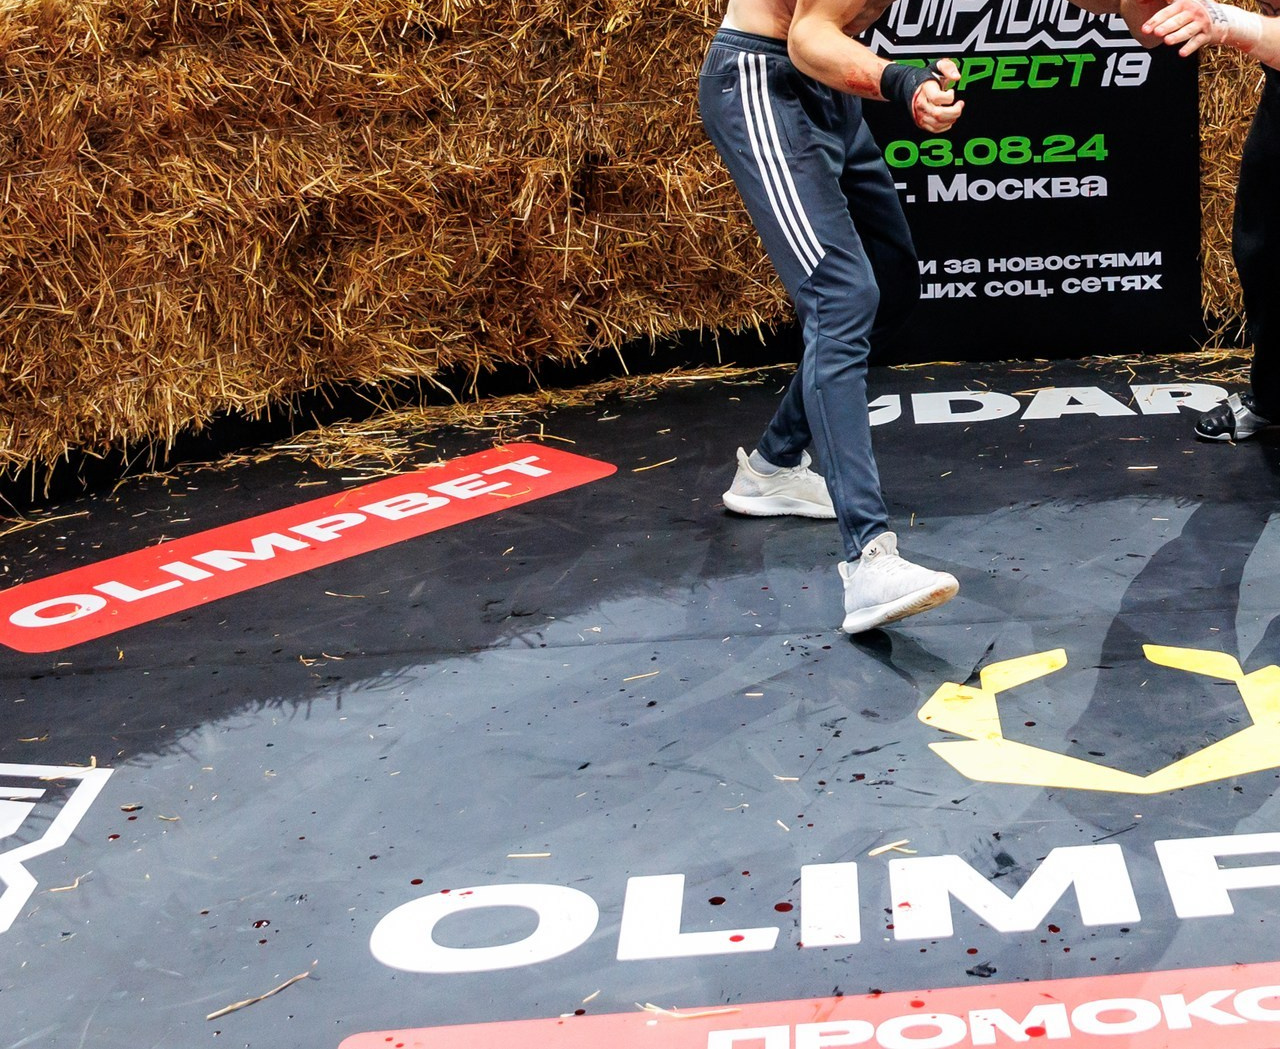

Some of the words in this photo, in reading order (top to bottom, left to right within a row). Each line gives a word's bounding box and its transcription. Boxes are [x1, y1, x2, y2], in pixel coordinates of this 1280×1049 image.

[1101, 52, 1152, 87] 19
[884, 133, 1108, 168] 03.08.24
[927, 173, 1108, 203] Москва
[944, 258, 981, 274] за
[984, 279, 1054, 298] соц.
[1061, 274, 1163, 294] сетях
[9, 455, 552, 628] OLIMPBET
